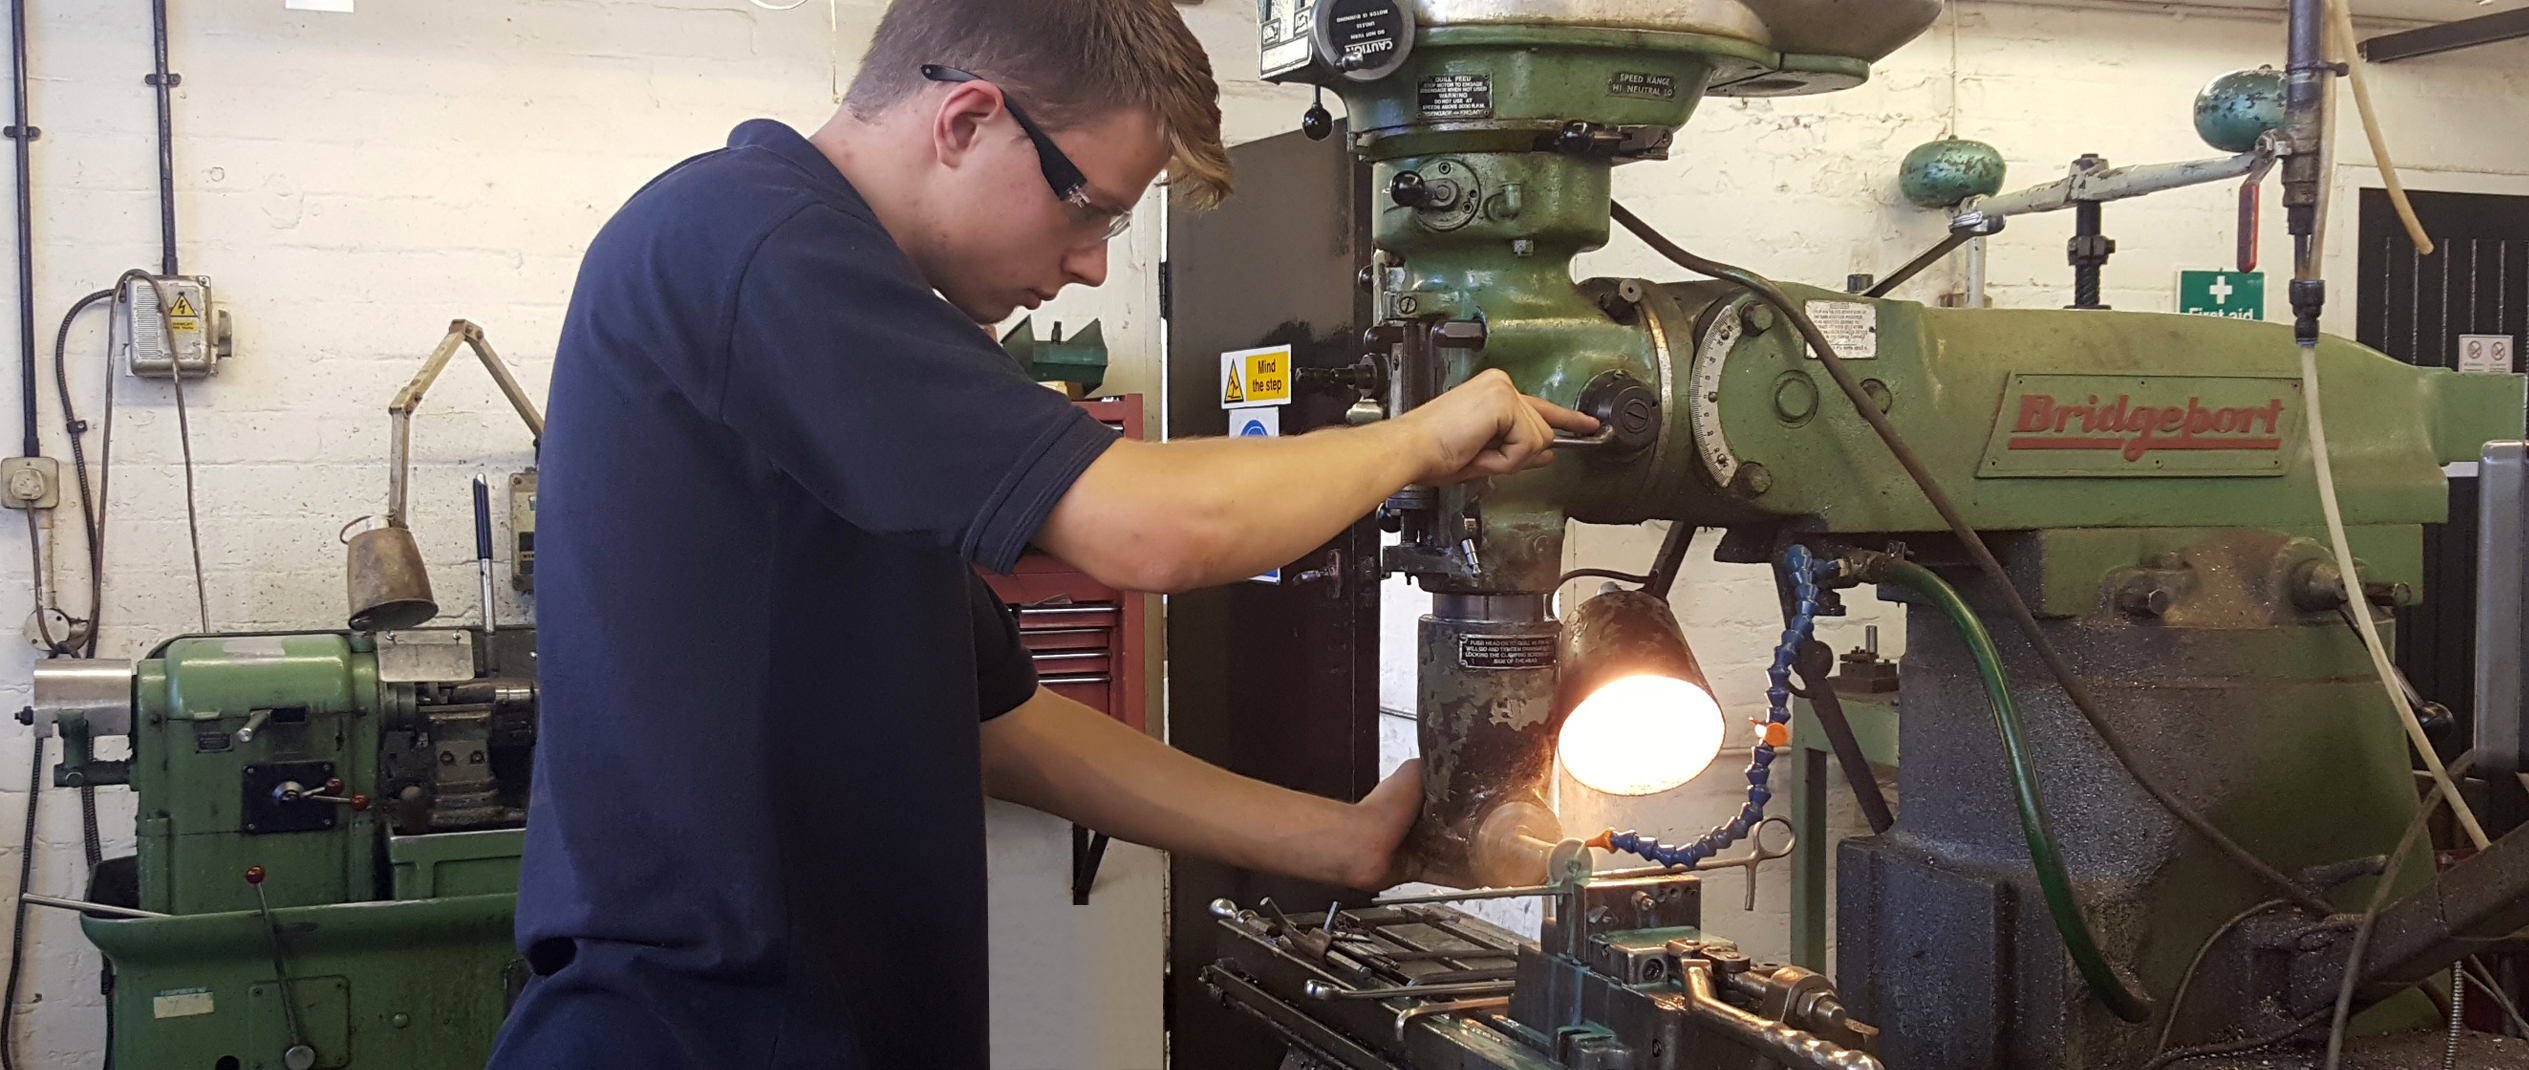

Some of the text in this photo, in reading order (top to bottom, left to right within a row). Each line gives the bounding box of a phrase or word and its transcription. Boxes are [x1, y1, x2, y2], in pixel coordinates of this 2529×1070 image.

[1336, 13, 1361, 23] RUNNING
[1369, 9, 1388, 17] MOTOR
[1356, 21, 1375, 29] UNLESS
[1620, 73, 1671, 86] SPEED RANGE
[1612, 84, 1622, 92] HI
[1627, 85, 1660, 95] NEUTRAL
[1258, 358, 1276, 374] Mind
[1252, 378, 1282, 394] the step
[2011, 394, 2284, 462] Bridgeport
